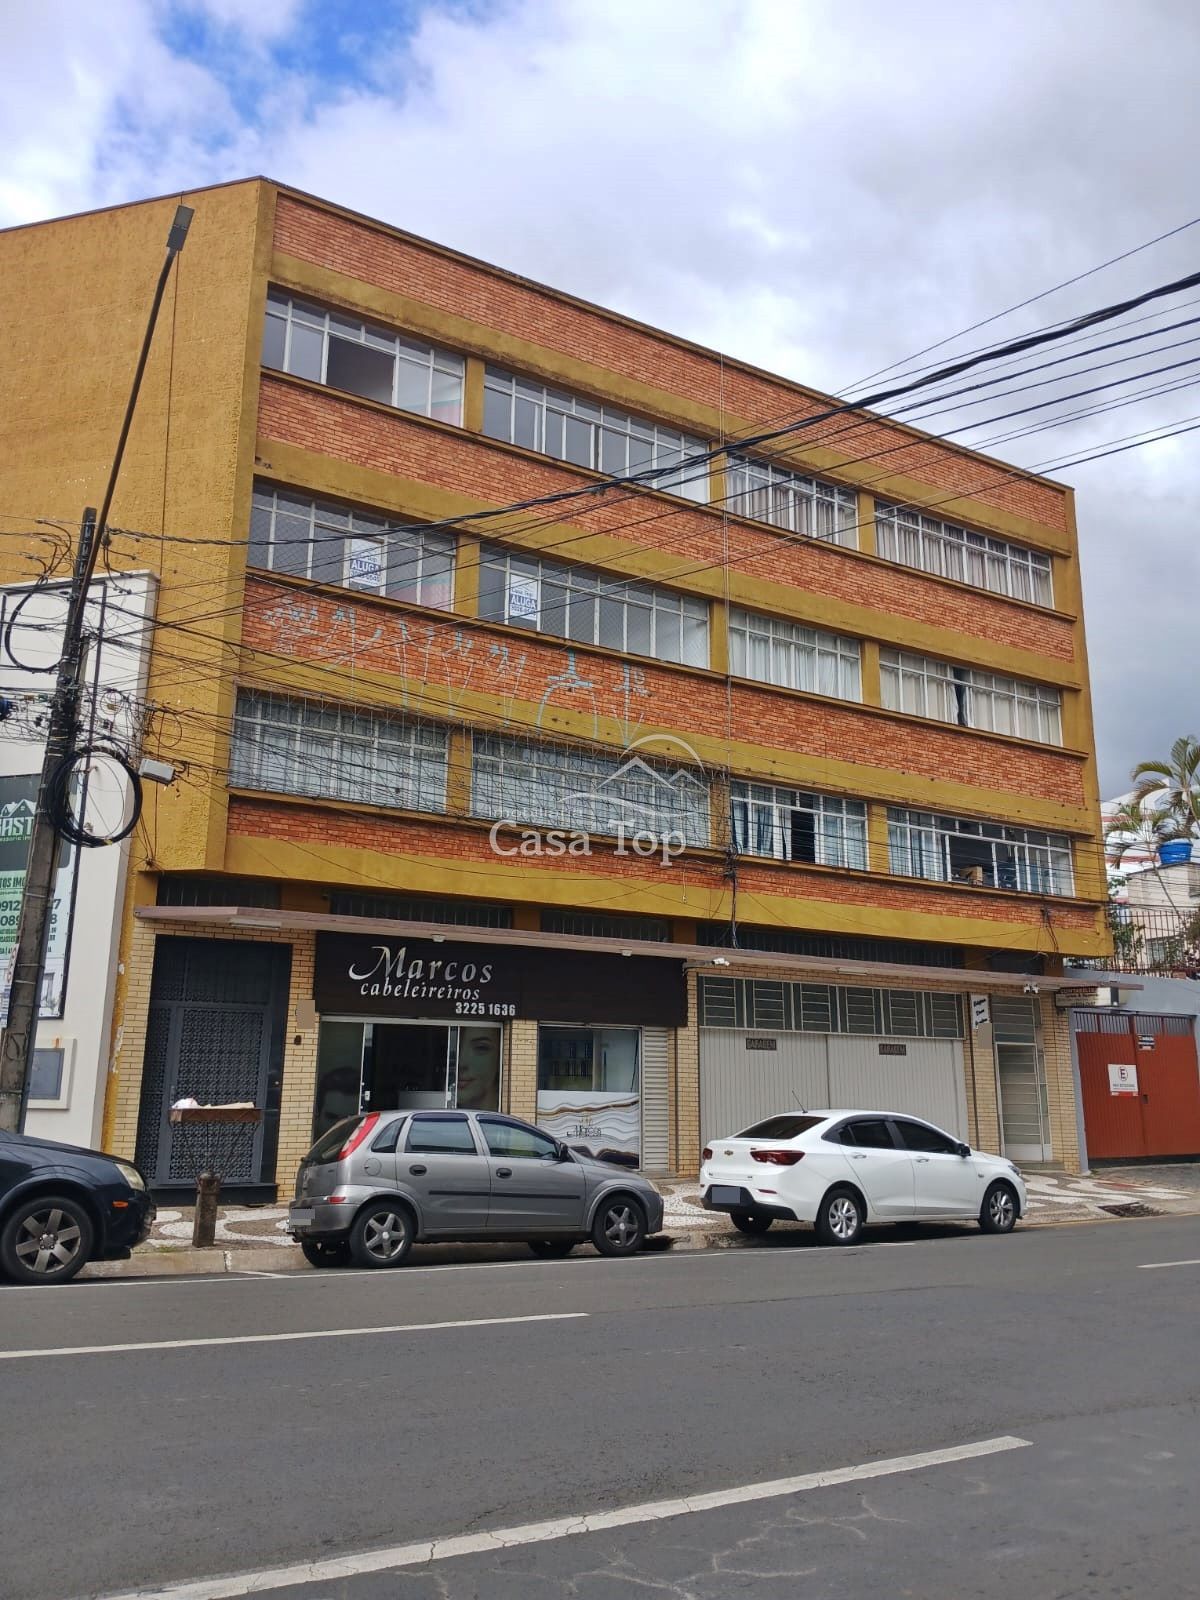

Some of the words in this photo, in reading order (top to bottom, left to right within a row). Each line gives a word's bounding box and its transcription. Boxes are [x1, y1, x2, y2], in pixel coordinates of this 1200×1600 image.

[351, 560, 381, 573] ALUGA
[511, 595, 537, 609] ALUGA
[348, 946, 493, 984] Marcos
[360, 976, 480, 1001] cabeleireiros
[455, 1002, 485, 1015] 3225
[488, 1003, 516, 1017] 1636
